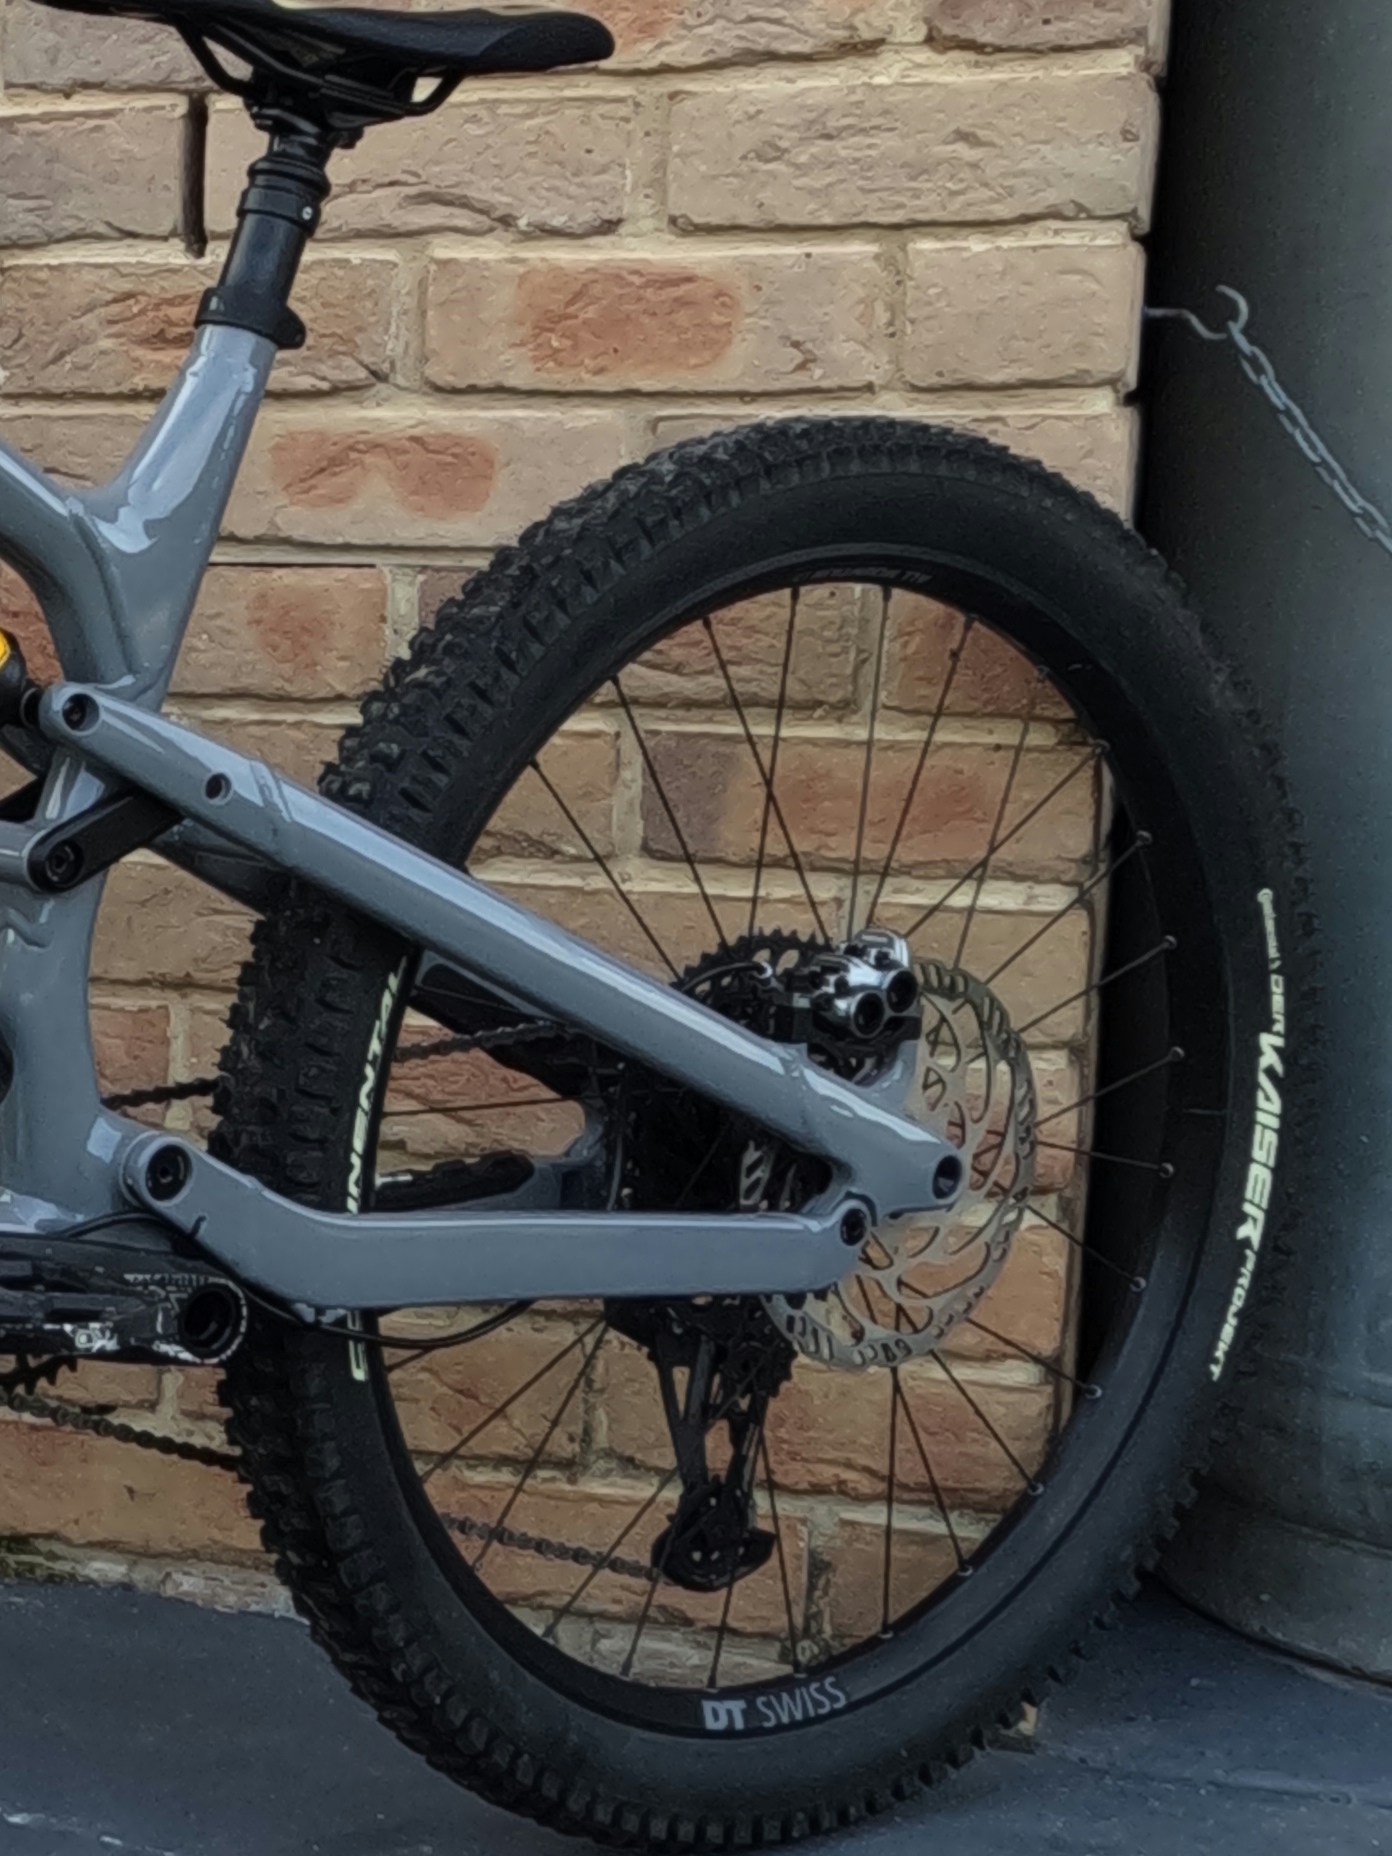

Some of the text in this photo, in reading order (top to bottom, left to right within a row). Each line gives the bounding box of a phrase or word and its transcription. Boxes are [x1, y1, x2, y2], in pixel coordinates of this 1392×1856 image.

[346, 955, 407, 1381] CINENTAL
[1209, 973, 1286, 1382] DER KAISER PROJEKT
[700, 1675, 848, 1731] DT SWISS
